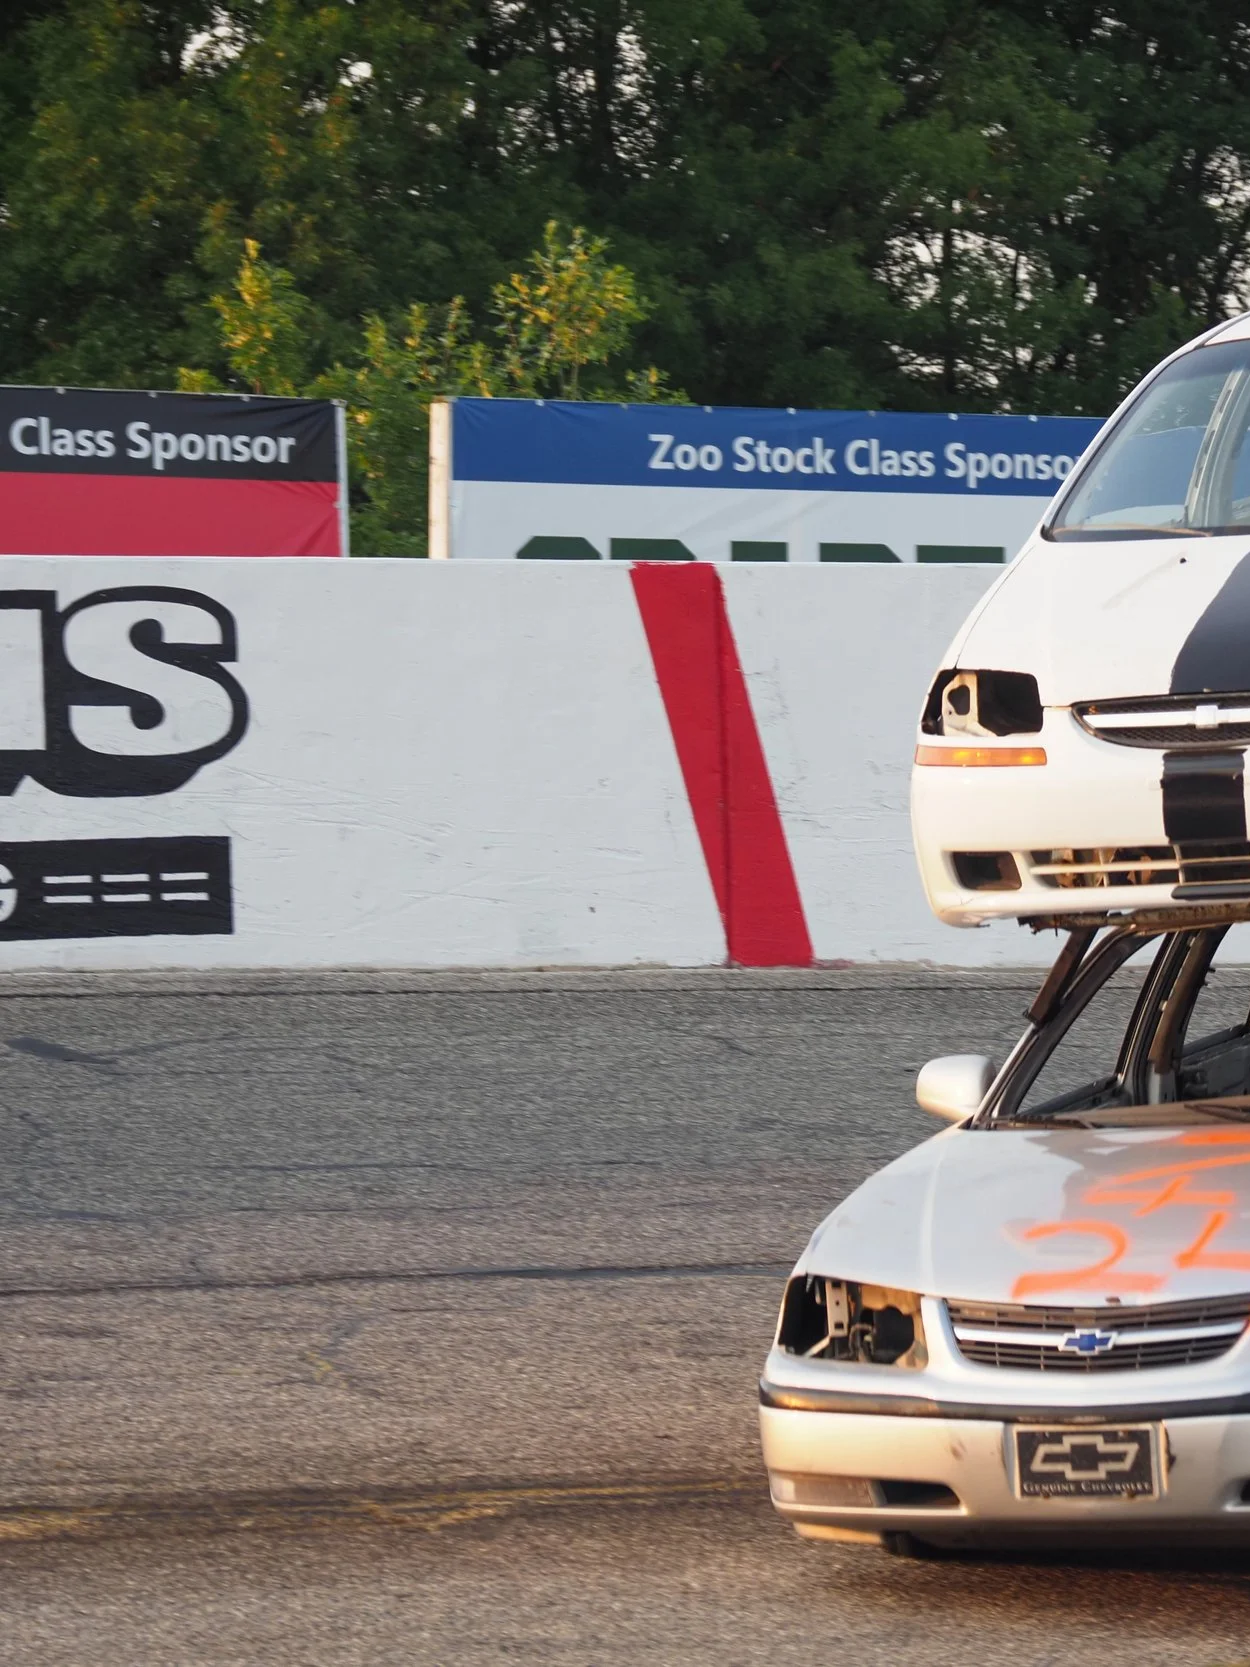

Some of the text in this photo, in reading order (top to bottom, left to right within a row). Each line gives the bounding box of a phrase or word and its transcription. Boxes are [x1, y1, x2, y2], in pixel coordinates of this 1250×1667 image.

[9, 416, 297, 470] Class Sponsor
[648, 434, 1081, 488] Zoo Stock Class Sponso
